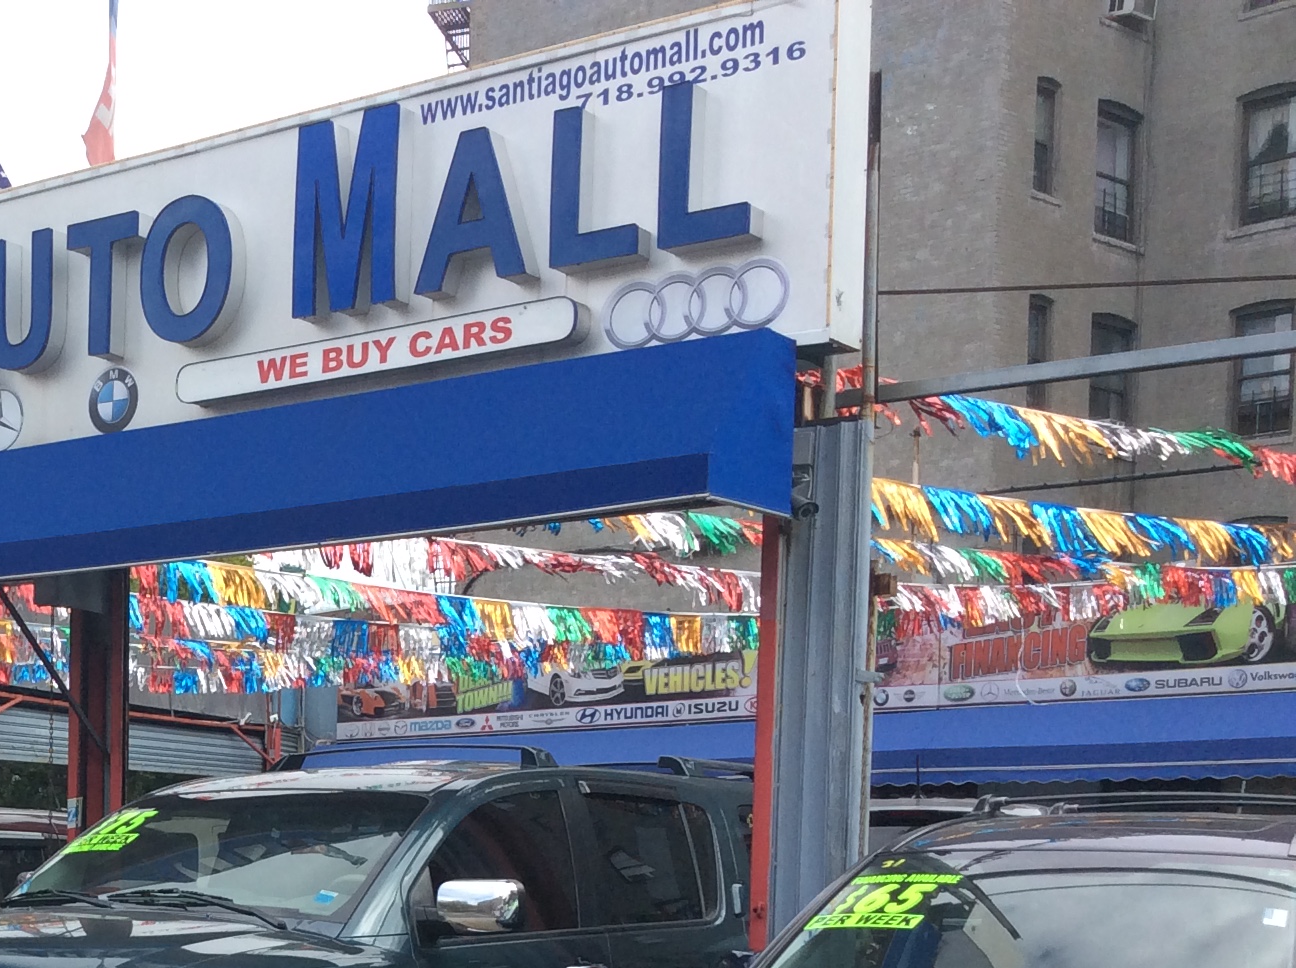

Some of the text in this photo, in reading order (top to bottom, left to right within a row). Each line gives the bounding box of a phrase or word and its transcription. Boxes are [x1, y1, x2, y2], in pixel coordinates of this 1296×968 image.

[420, 19, 765, 126] www.santiagoautomall.com
[575, 40, 807, 110] 718.992.9316
[292, 80, 751, 319] MALL
[257, 316, 513, 384] WE BUY CARS
[93, 369, 135, 393] BMW
[950, 623, 1088, 682] FINANCING
[1154, 676, 1223, 690] SUBARU
[1249, 670, 1296, 682] Volkswa
[603, 704, 670, 721] HYUNDAI
[687, 700, 740, 715] ISUZU
[832, 883, 939, 914] $65
[812, 914, 921, 928] PER WEEK
